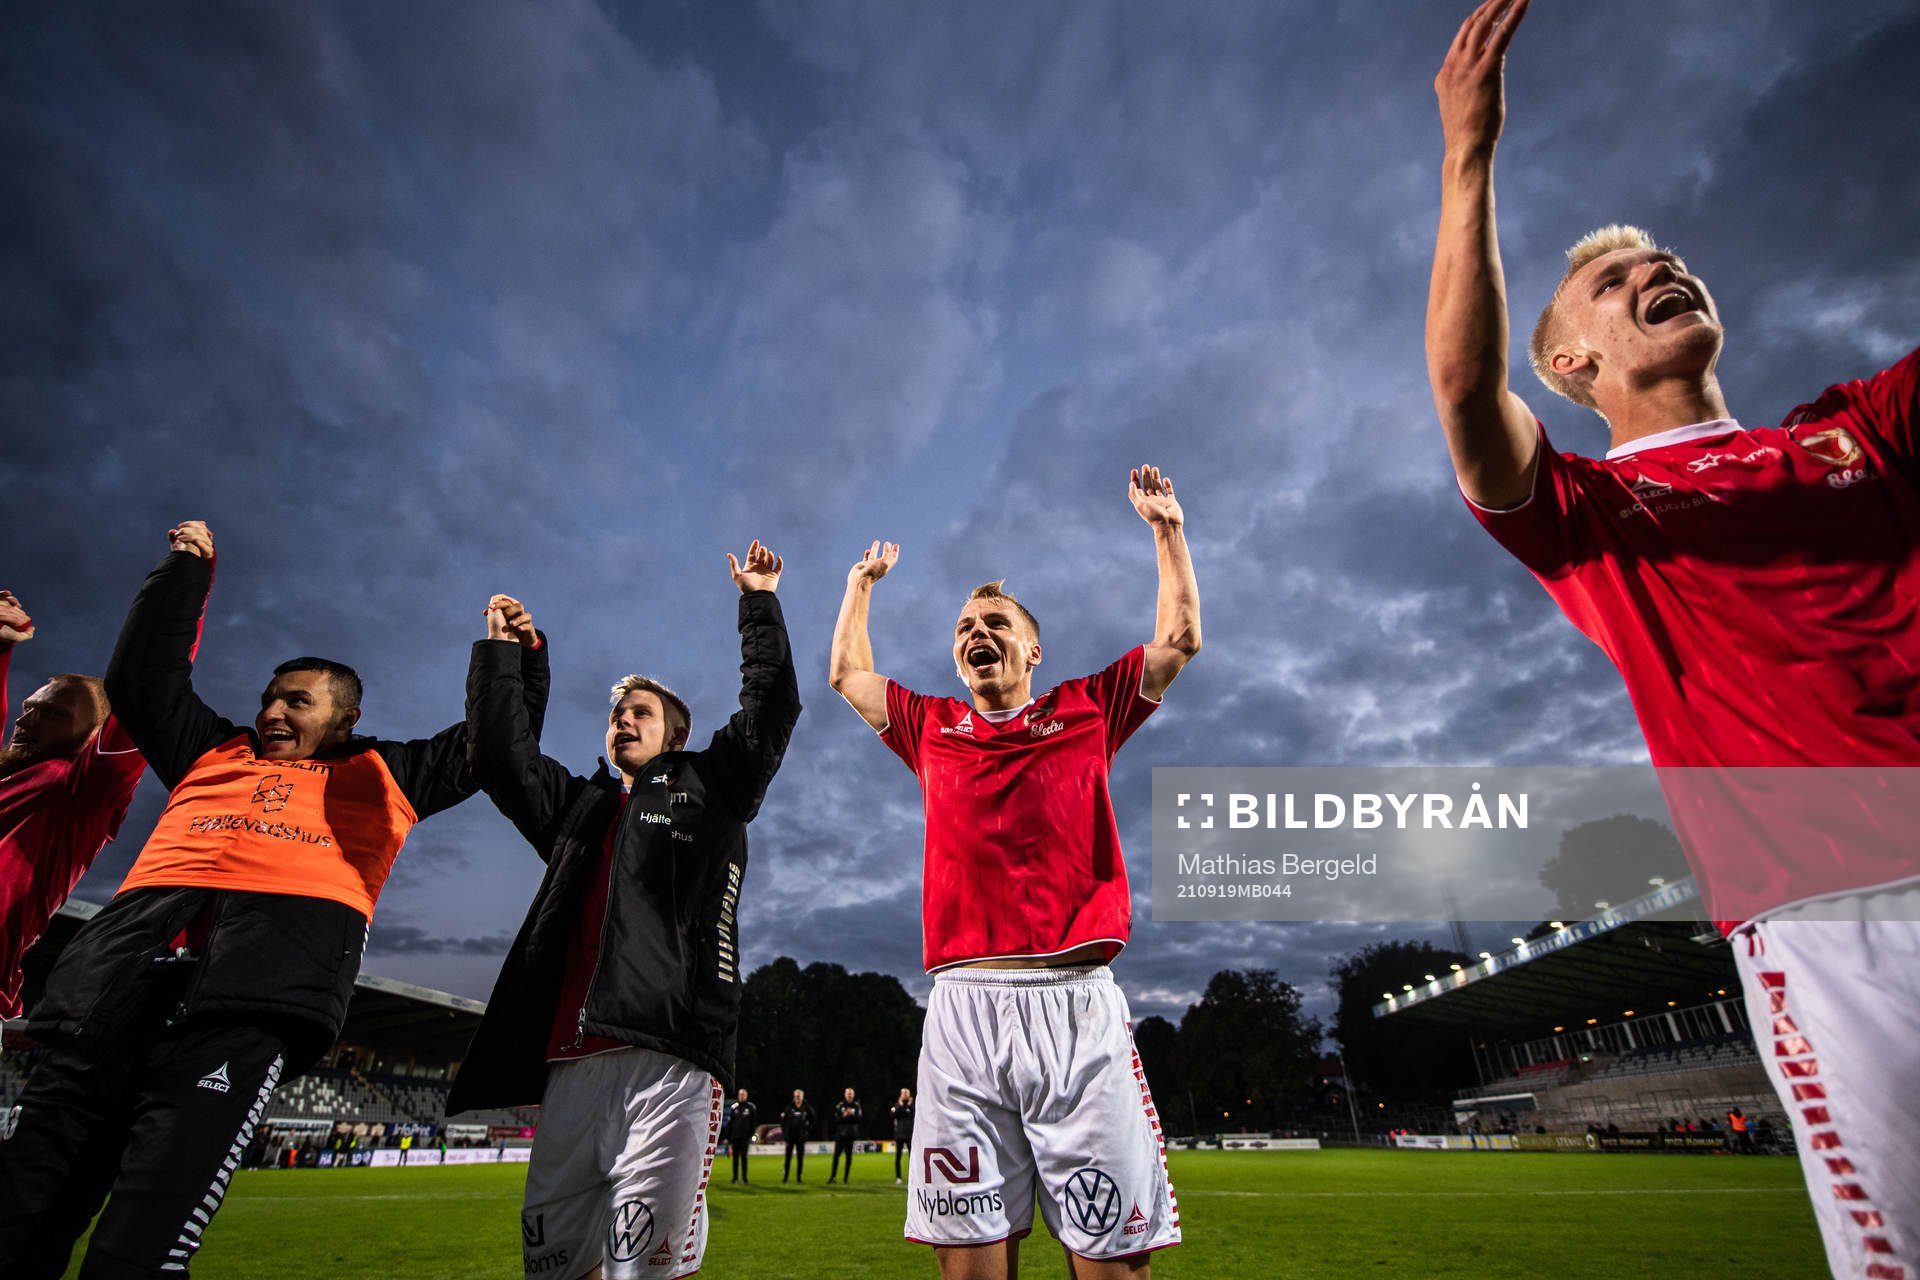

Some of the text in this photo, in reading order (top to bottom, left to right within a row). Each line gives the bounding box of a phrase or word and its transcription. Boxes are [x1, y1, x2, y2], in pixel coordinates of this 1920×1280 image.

[197, 1079, 230, 1094] SELECT
[917, 1187, 1003, 1223] Nybloms
[1123, 1222, 1149, 1235] SELECT
[648, 1256, 672, 1266] SELECT
